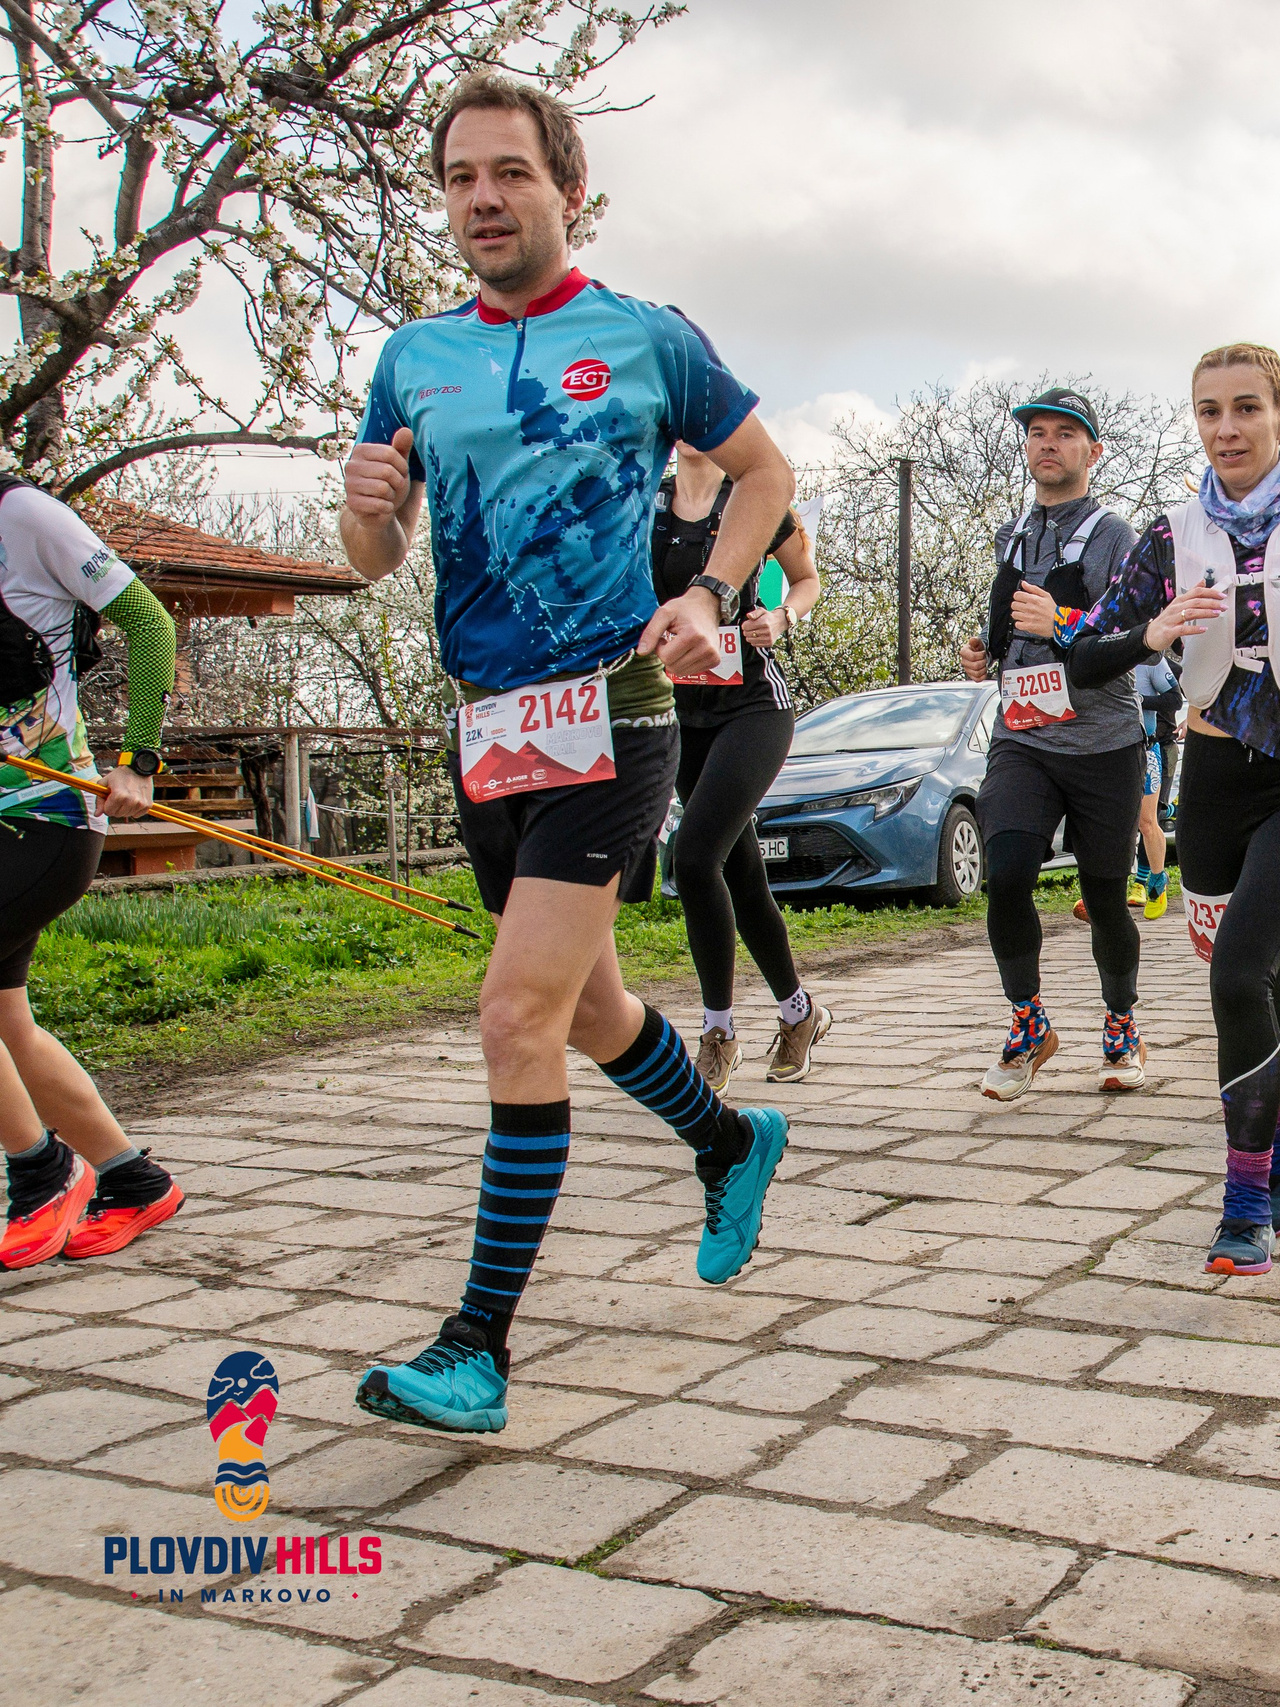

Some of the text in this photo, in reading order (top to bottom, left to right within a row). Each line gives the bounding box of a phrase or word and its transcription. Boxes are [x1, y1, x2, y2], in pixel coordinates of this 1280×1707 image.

[569, 371, 611, 386] EGT
[81, 560, 97, 578] ПО
[1017, 670, 1062, 697] 2209
[475, 702, 497, 713] PLOVDIV
[518, 685, 600, 734] 2142
[476, 711, 490, 720] HILLS
[466, 728, 483, 743] 22K
[546, 724, 602, 745] MARKOVO
[546, 741, 576, 756] TRAIL
[770, 841, 786, 856] HC
